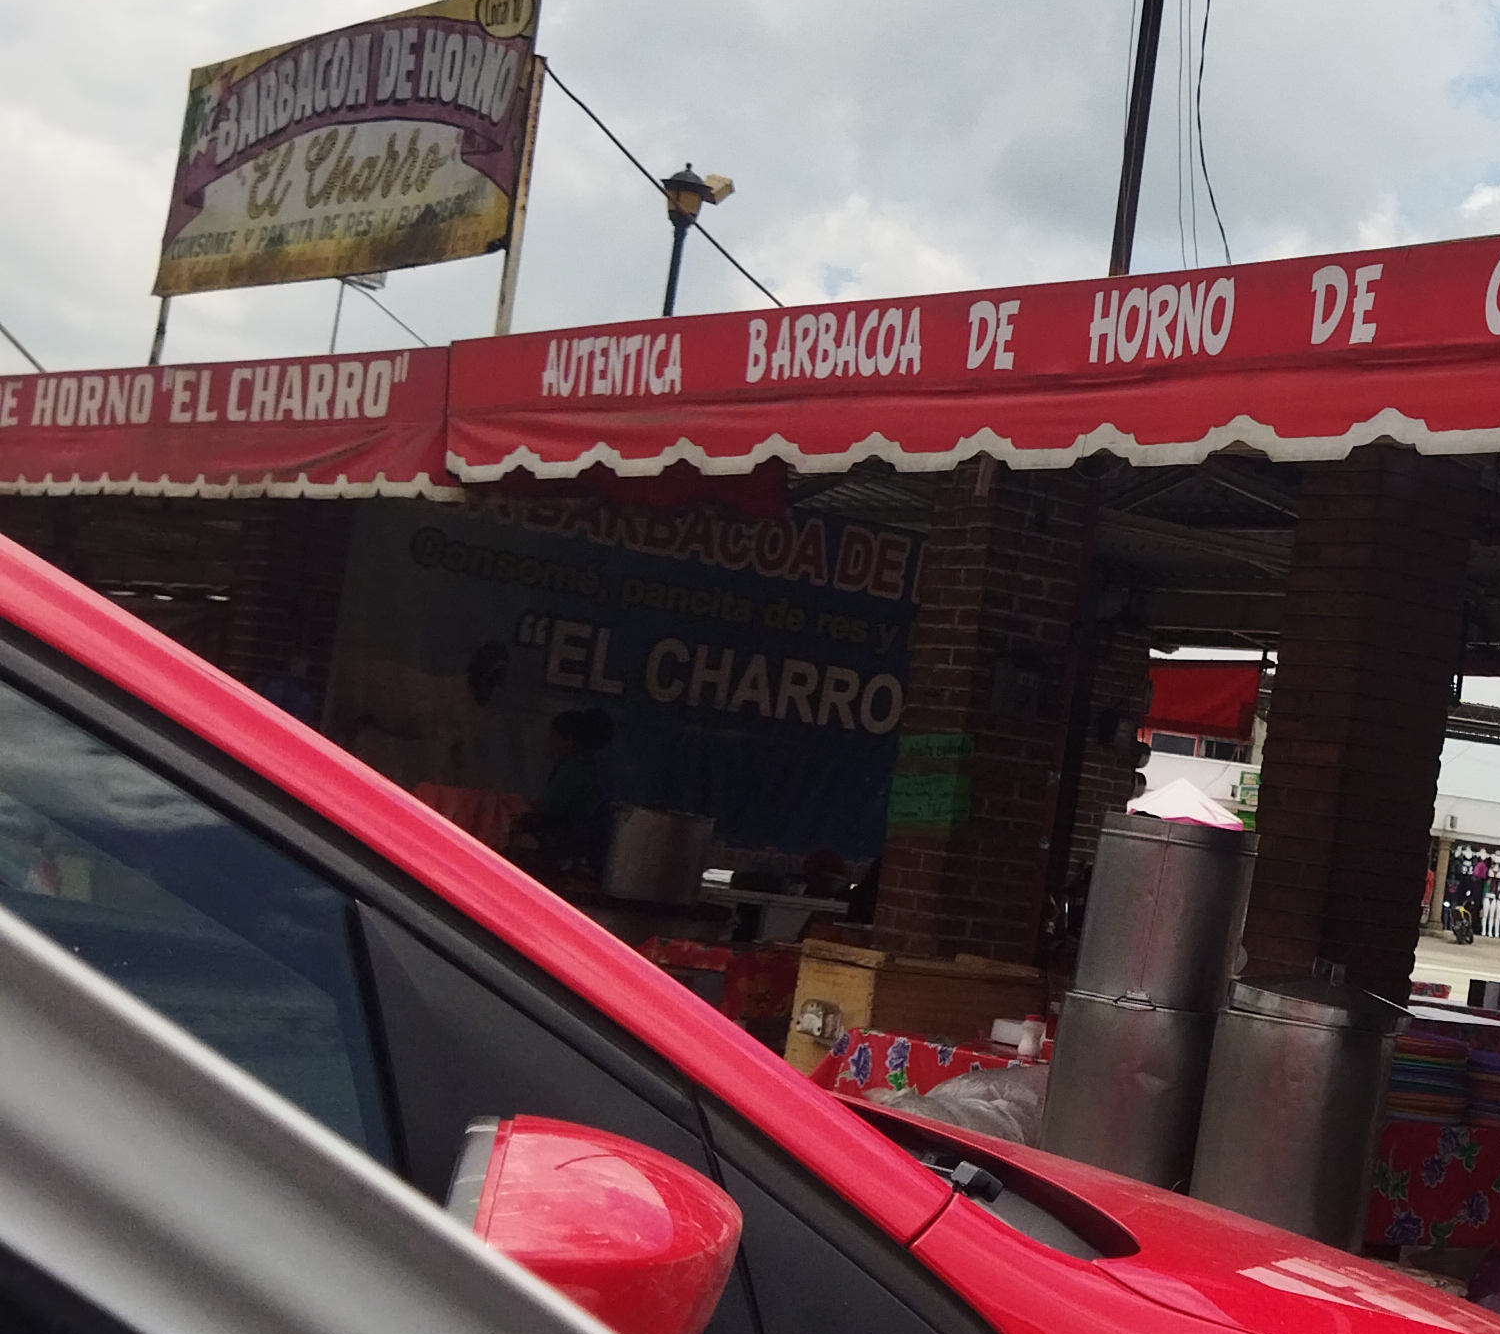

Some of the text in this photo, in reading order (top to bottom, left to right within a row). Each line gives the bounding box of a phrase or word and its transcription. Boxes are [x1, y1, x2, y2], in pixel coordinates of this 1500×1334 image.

[214, 32, 373, 166] BARBACOA
[375, 26, 421, 101] DE
[419, 28, 521, 124] HORNO
[247, 139, 296, 220] El
[304, 126, 453, 209] Charro
[541, 333, 682, 398] AUTENTICA
[746, 306, 922, 384] BARBACOA
[967, 299, 1021, 371] DE
[1088, 276, 1236, 364] HORNO
[1311, 263, 1384, 346] DE
[0, 351, 411, 428] E HORNO "EL CHARRO"
[833, 525, 912, 600] DE
[620, 573, 753, 625] pancita
[762, 596, 807, 632] de
[815, 609, 868, 645] res
[876, 622, 900, 656] y
[644, 637, 904, 736] CHARRO
